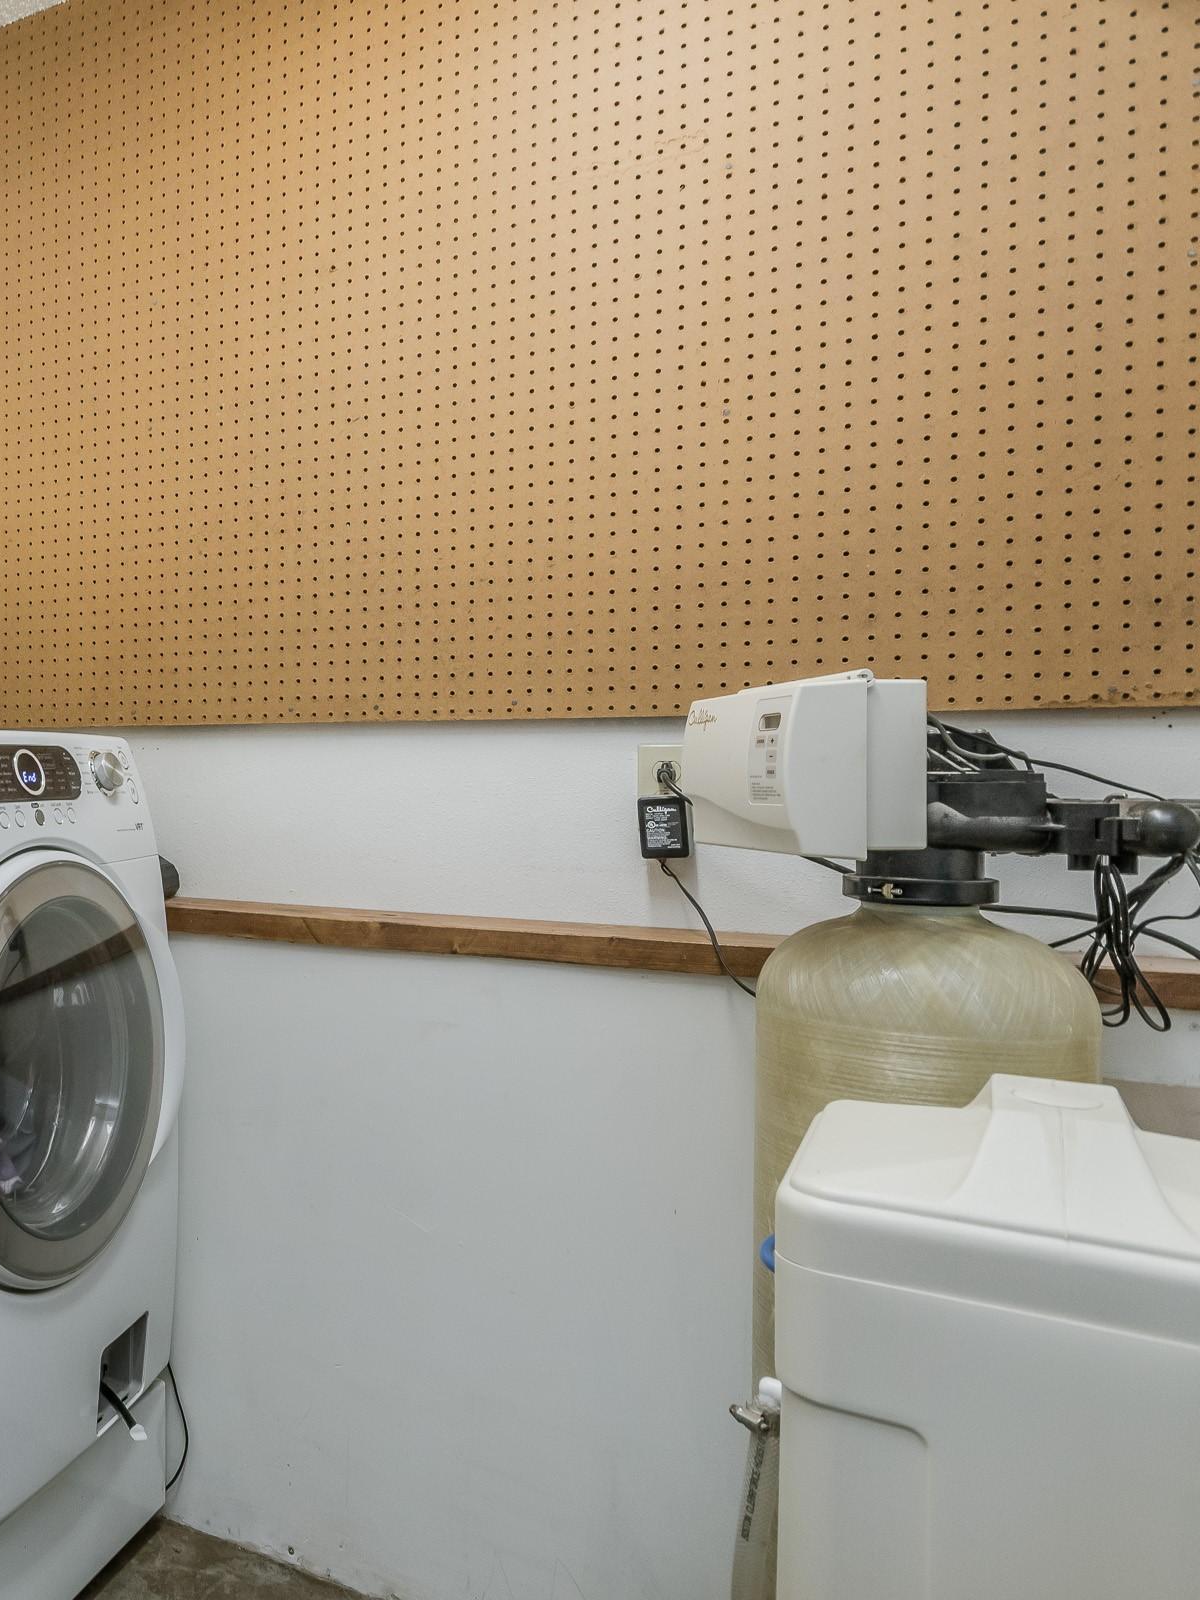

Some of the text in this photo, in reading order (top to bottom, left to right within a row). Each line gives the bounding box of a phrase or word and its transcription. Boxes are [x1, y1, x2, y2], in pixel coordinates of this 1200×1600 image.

[688, 707, 718, 731] Culligan
[22, 771, 37, 782] End
[647, 806, 676, 814] Culligan
